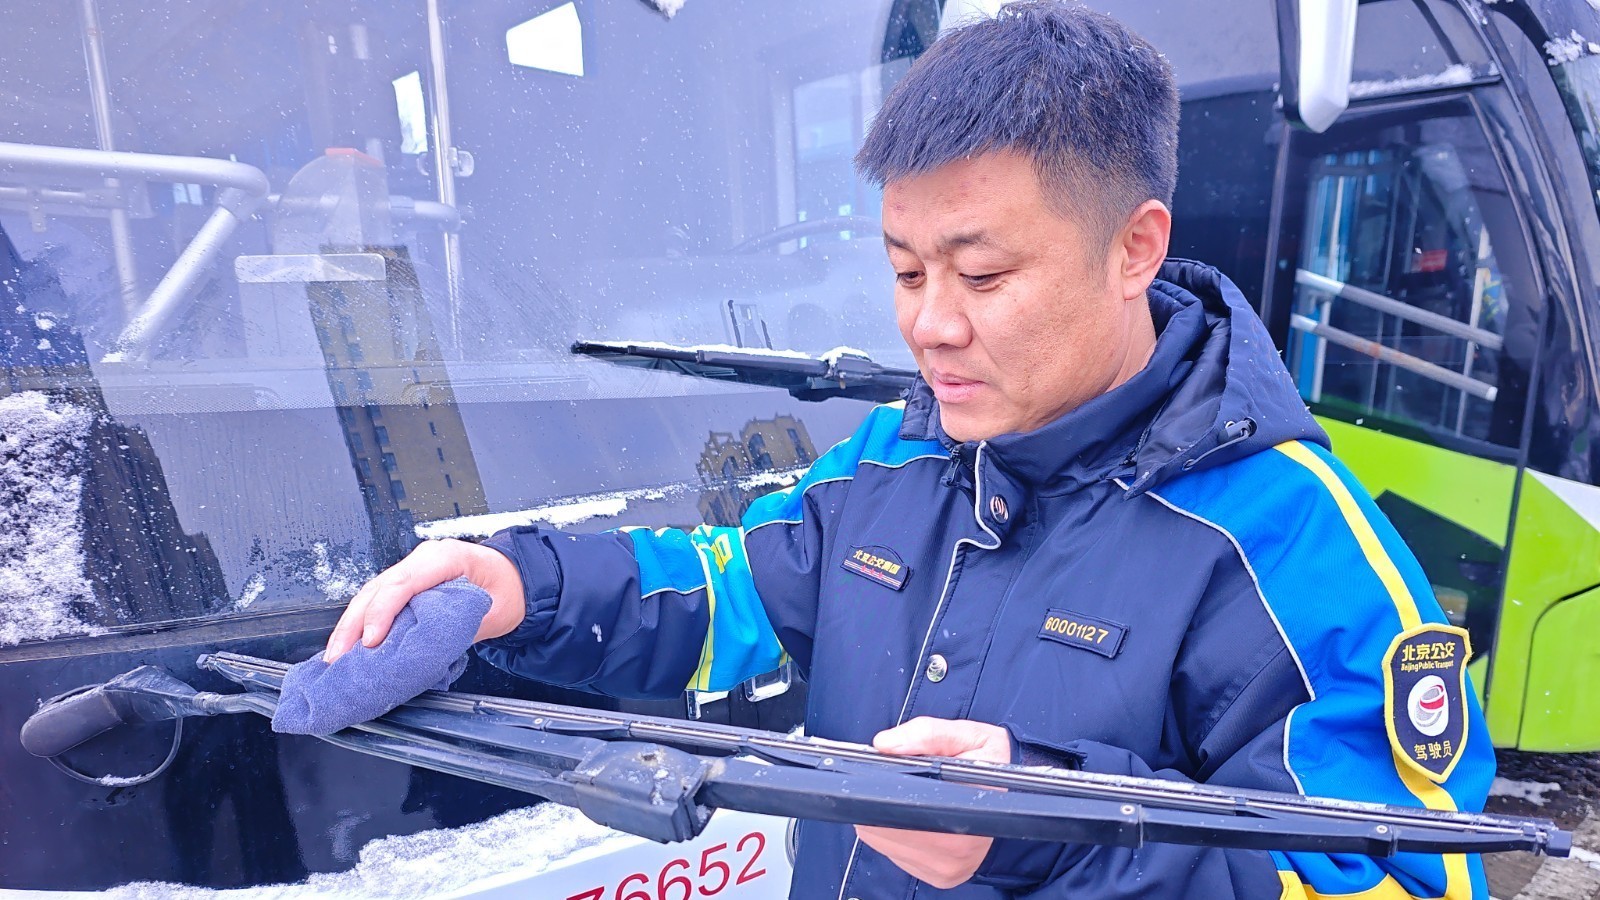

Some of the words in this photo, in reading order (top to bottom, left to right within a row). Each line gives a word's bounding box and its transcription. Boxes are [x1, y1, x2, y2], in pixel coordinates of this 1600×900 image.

[1045, 617, 1109, 644] 60001127
[1402, 642, 1456, 662] 北京公交
[1401, 663, 1418, 673] Beijing
[1419, 661, 1435, 670] Public
[1414, 740, 1453, 761] 驾驶员
